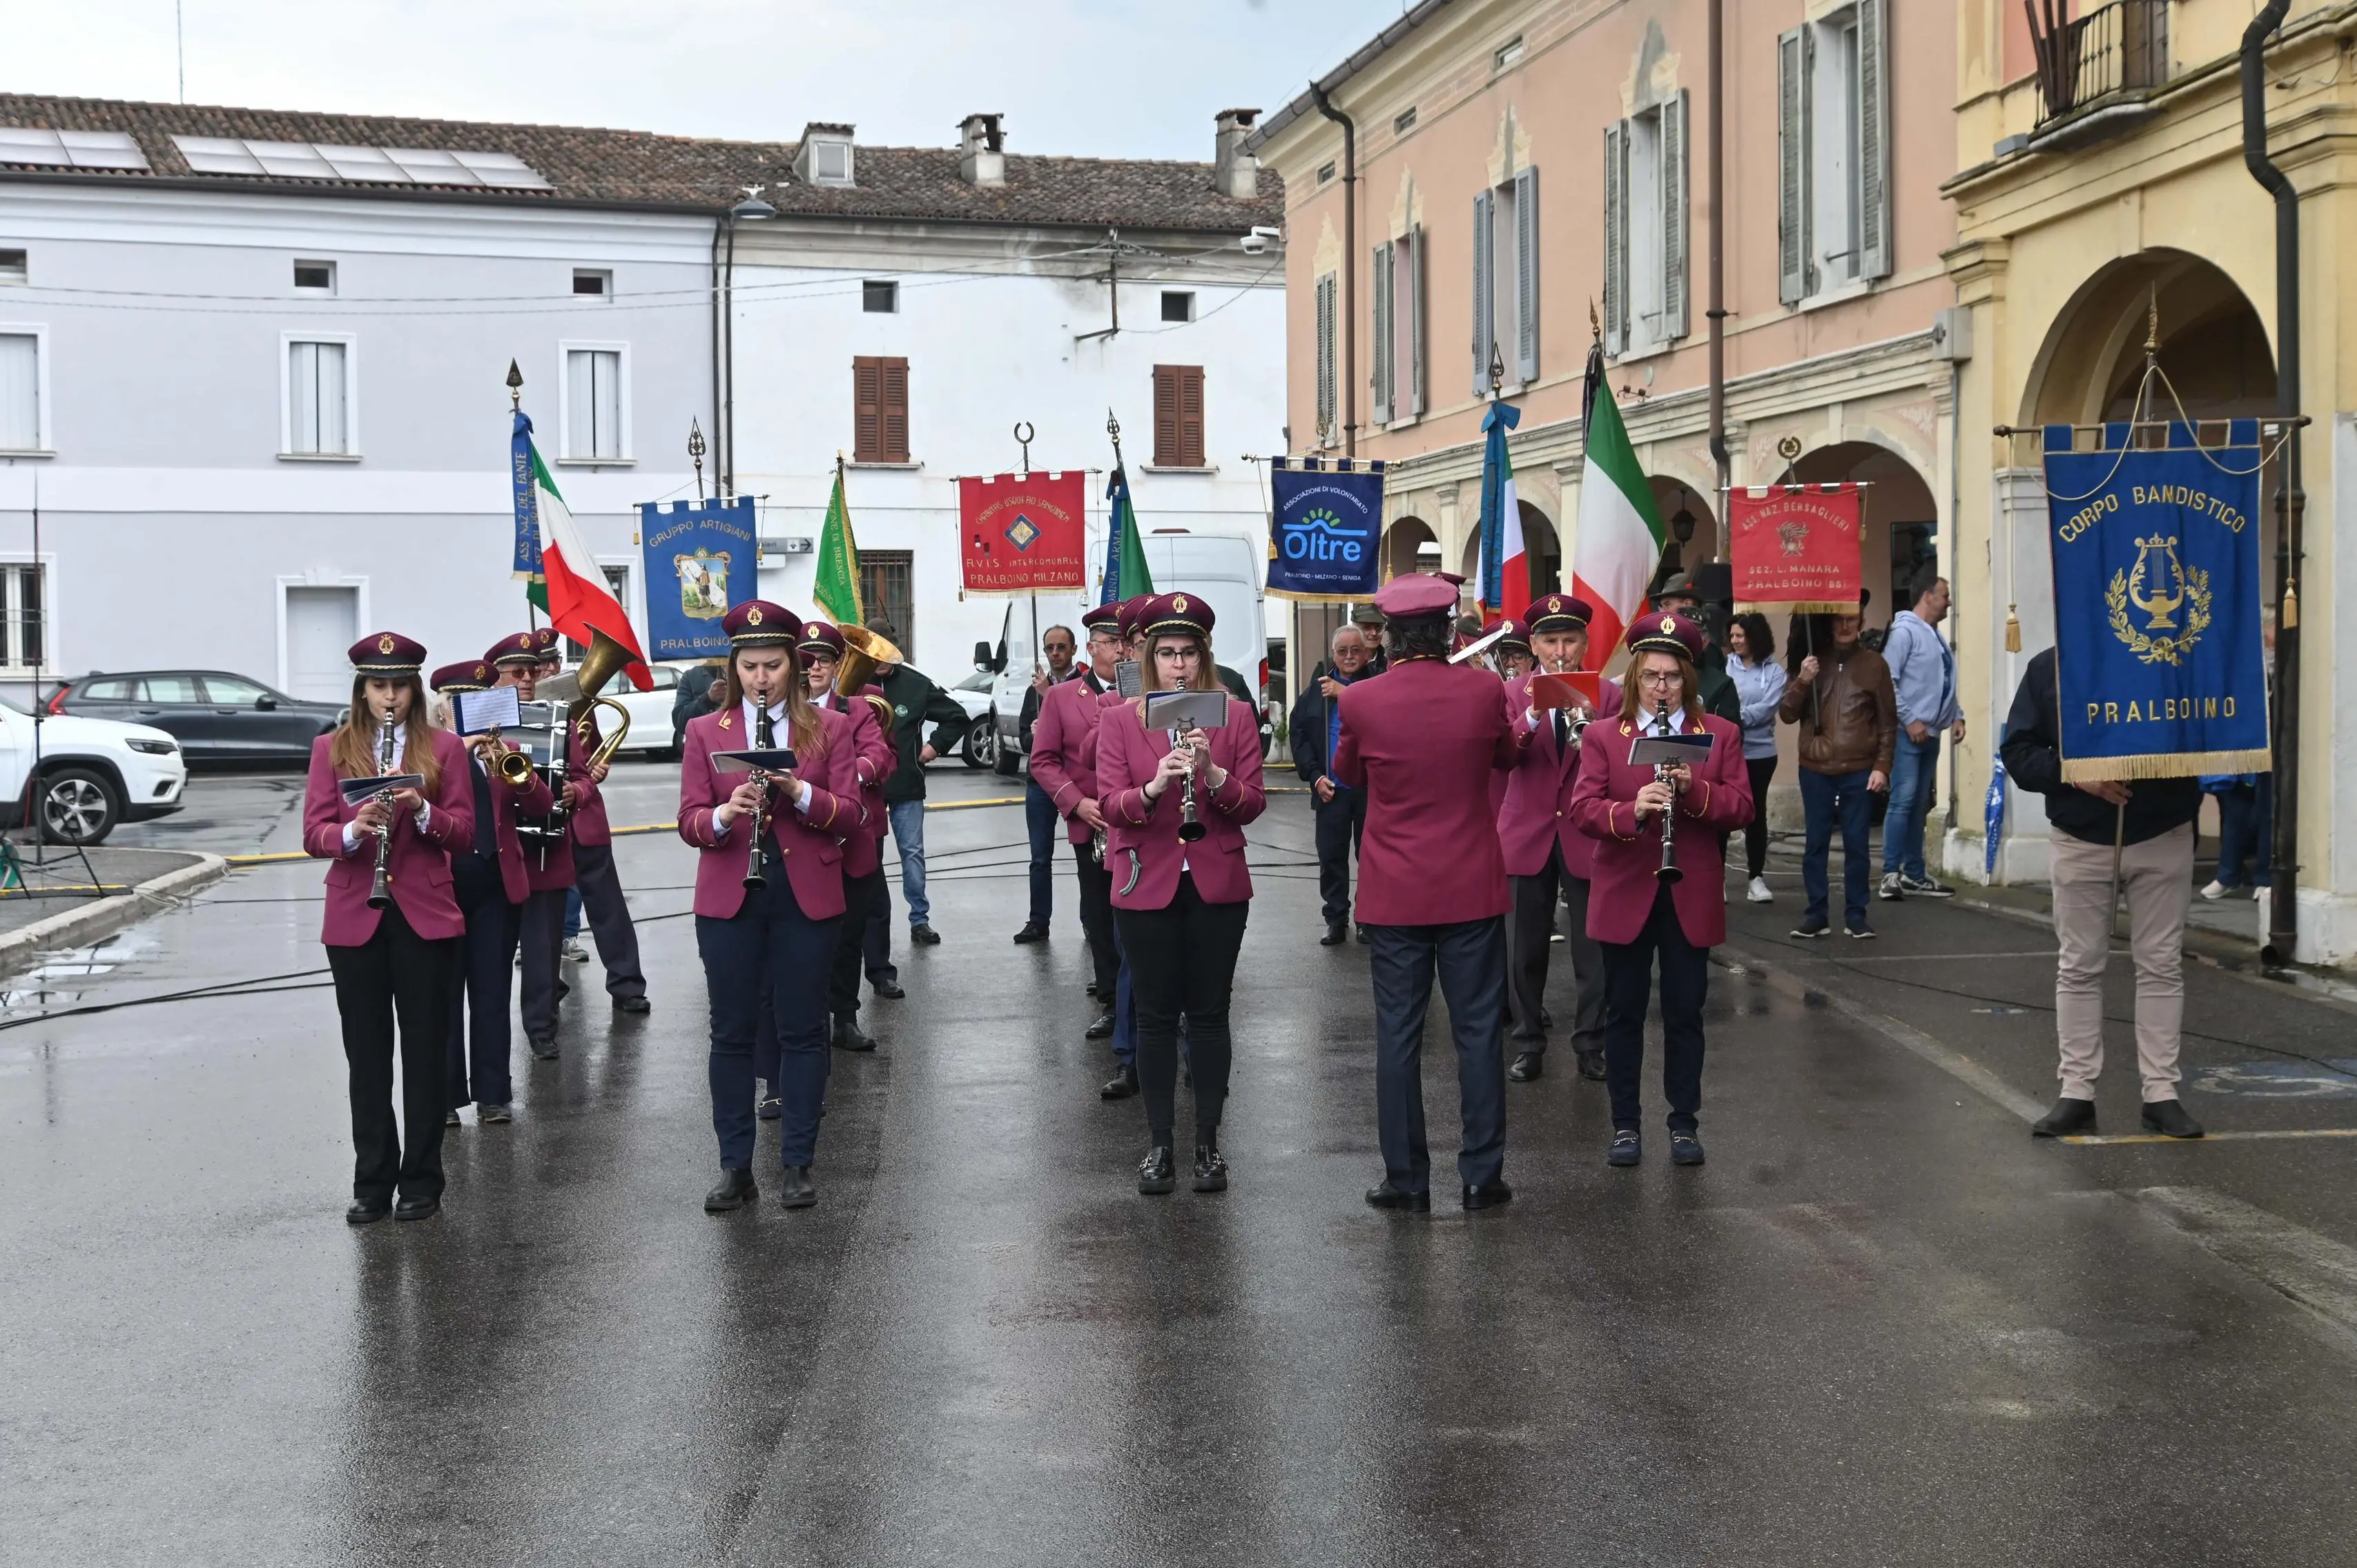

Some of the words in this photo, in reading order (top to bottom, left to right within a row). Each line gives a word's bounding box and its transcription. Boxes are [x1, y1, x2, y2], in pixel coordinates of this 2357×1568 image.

[515, 452, 527, 484] FANTE
[517, 490, 528, 509] DEL
[976, 501, 1004, 525] CHARITAS
[1004, 496, 1025, 507] USQUE
[1038, 499, 1070, 523] SANGUINEM
[1283, 486, 1321, 511] ASSOCIAZIONE
[1330, 487, 1368, 514] VOLONTARIATO
[2059, 494, 2119, 543] CORPO
[2132, 485, 2246, 533] BANDISTICO
[1742, 515, 1760, 531] ASS.
[1760, 505, 1781, 519] NAZ.
[1784, 502, 1850, 532] BERSAGLIERI
[649, 521, 694, 548] GRUPPO
[699, 519, 751, 542] ARTIGIANI
[832, 533, 840, 541] DI
[1111, 530, 1121, 562] ARMA
[1285, 531, 1361, 562] Oltre
[834, 547, 846, 585] BRESCIA
[1009, 557, 1080, 568] INTERCOMUNALE
[1749, 566, 1773, 574] SEZ.
[1777, 565, 1787, 574] L.
[1789, 565, 1840, 574] MANARA
[970, 573, 1029, 584] PRALBOINO
[1034, 572, 1078, 582] MILZANO
[1747, 578, 1822, 589] PRALBOINO
[660, 637, 730, 650] PRALBOINO
[2087, 696, 2236, 725] PRALBOINO
